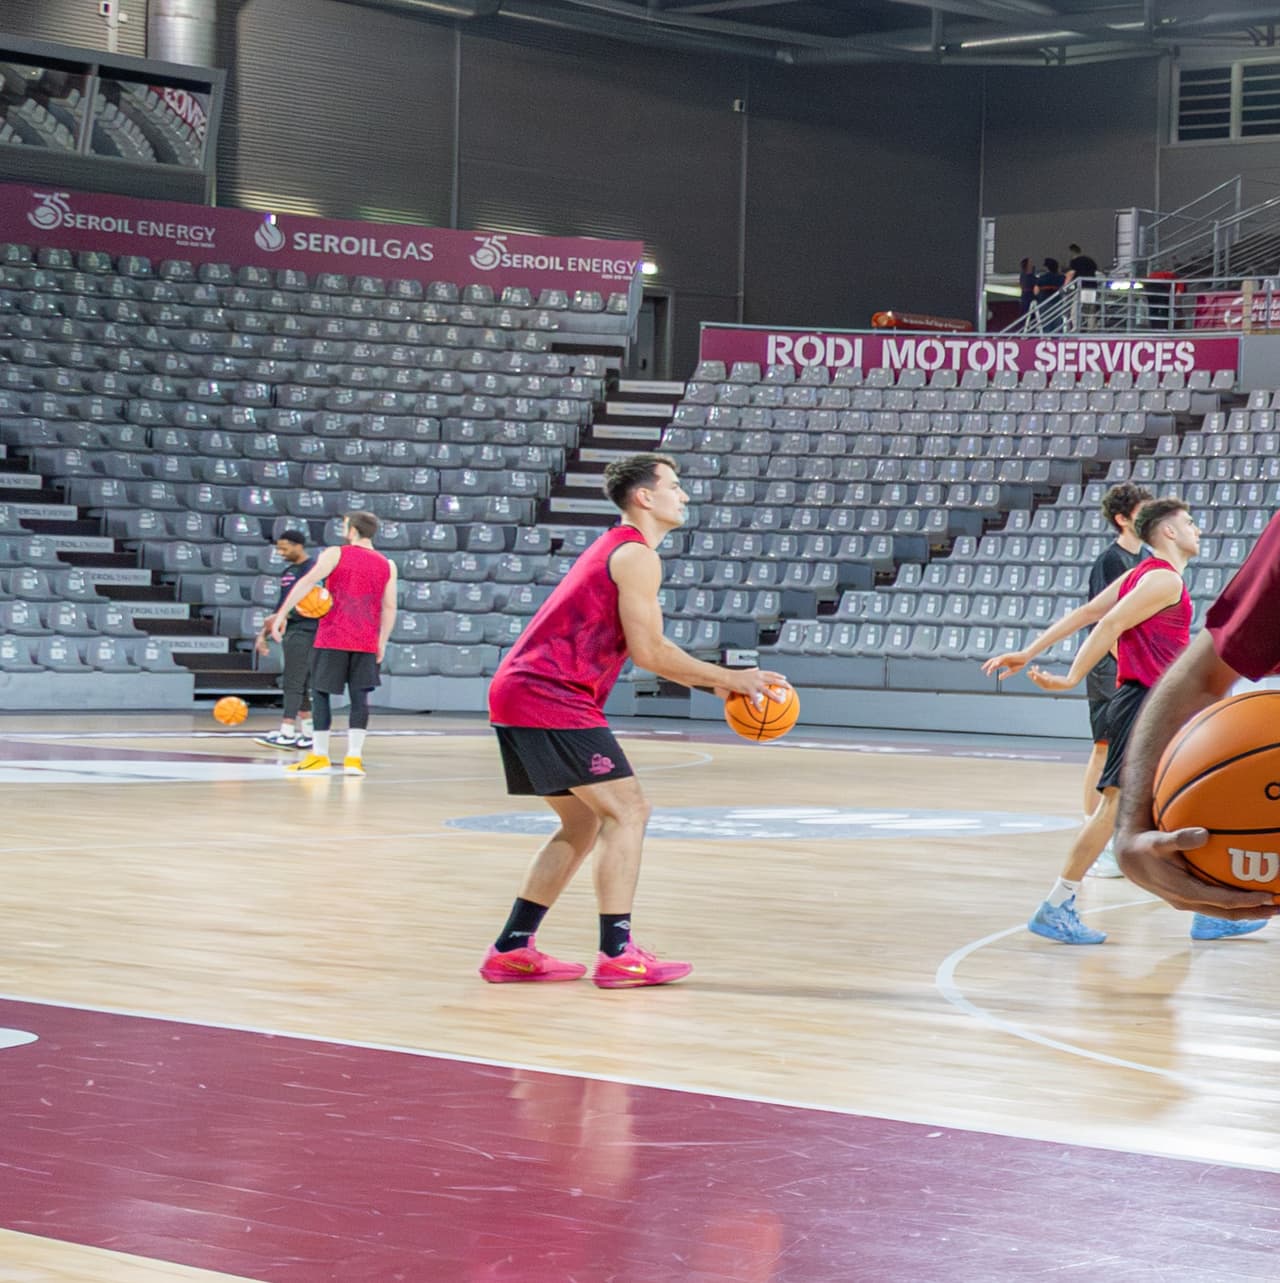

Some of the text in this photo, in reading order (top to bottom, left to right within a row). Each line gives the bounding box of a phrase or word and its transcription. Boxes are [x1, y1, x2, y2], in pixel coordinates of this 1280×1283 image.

[63, 212, 133, 235] SEROIL
[137, 221, 216, 242] ENERGY
[294, 232, 433, 263] SEROILGAS
[501, 253, 564, 272] SEROIL
[568, 257, 637, 275] ENERGY
[767, 334, 1196, 373] RODI MOTOR SERVICES
